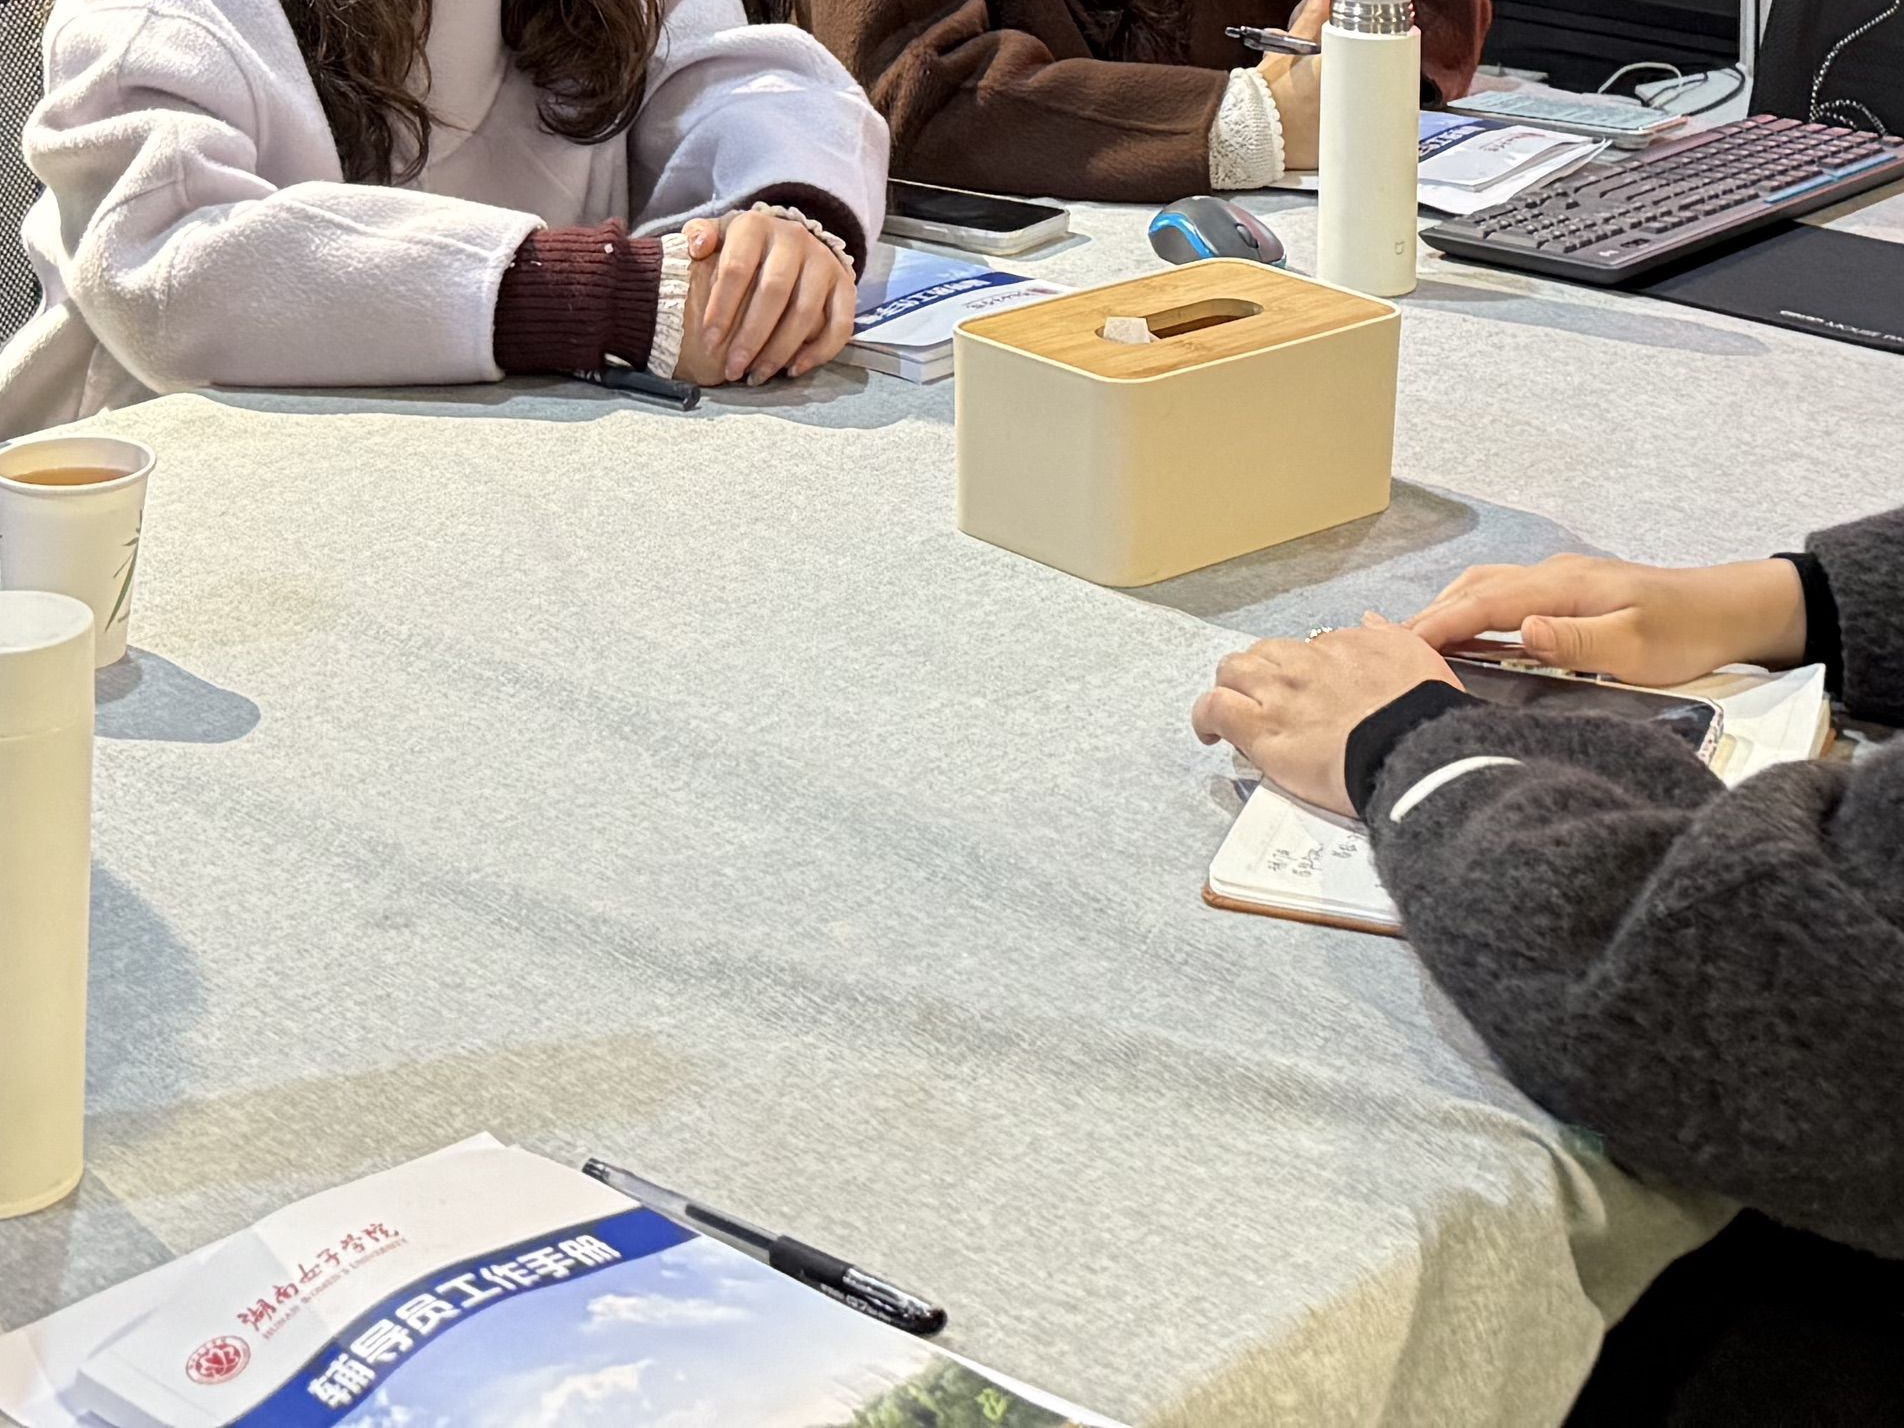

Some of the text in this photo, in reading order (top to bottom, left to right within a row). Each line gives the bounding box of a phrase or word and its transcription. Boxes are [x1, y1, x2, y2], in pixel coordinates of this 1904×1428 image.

[237, 1223, 400, 1331] 湖南女子学院
[307, 1233, 622, 1410] 辅导员工作手册
